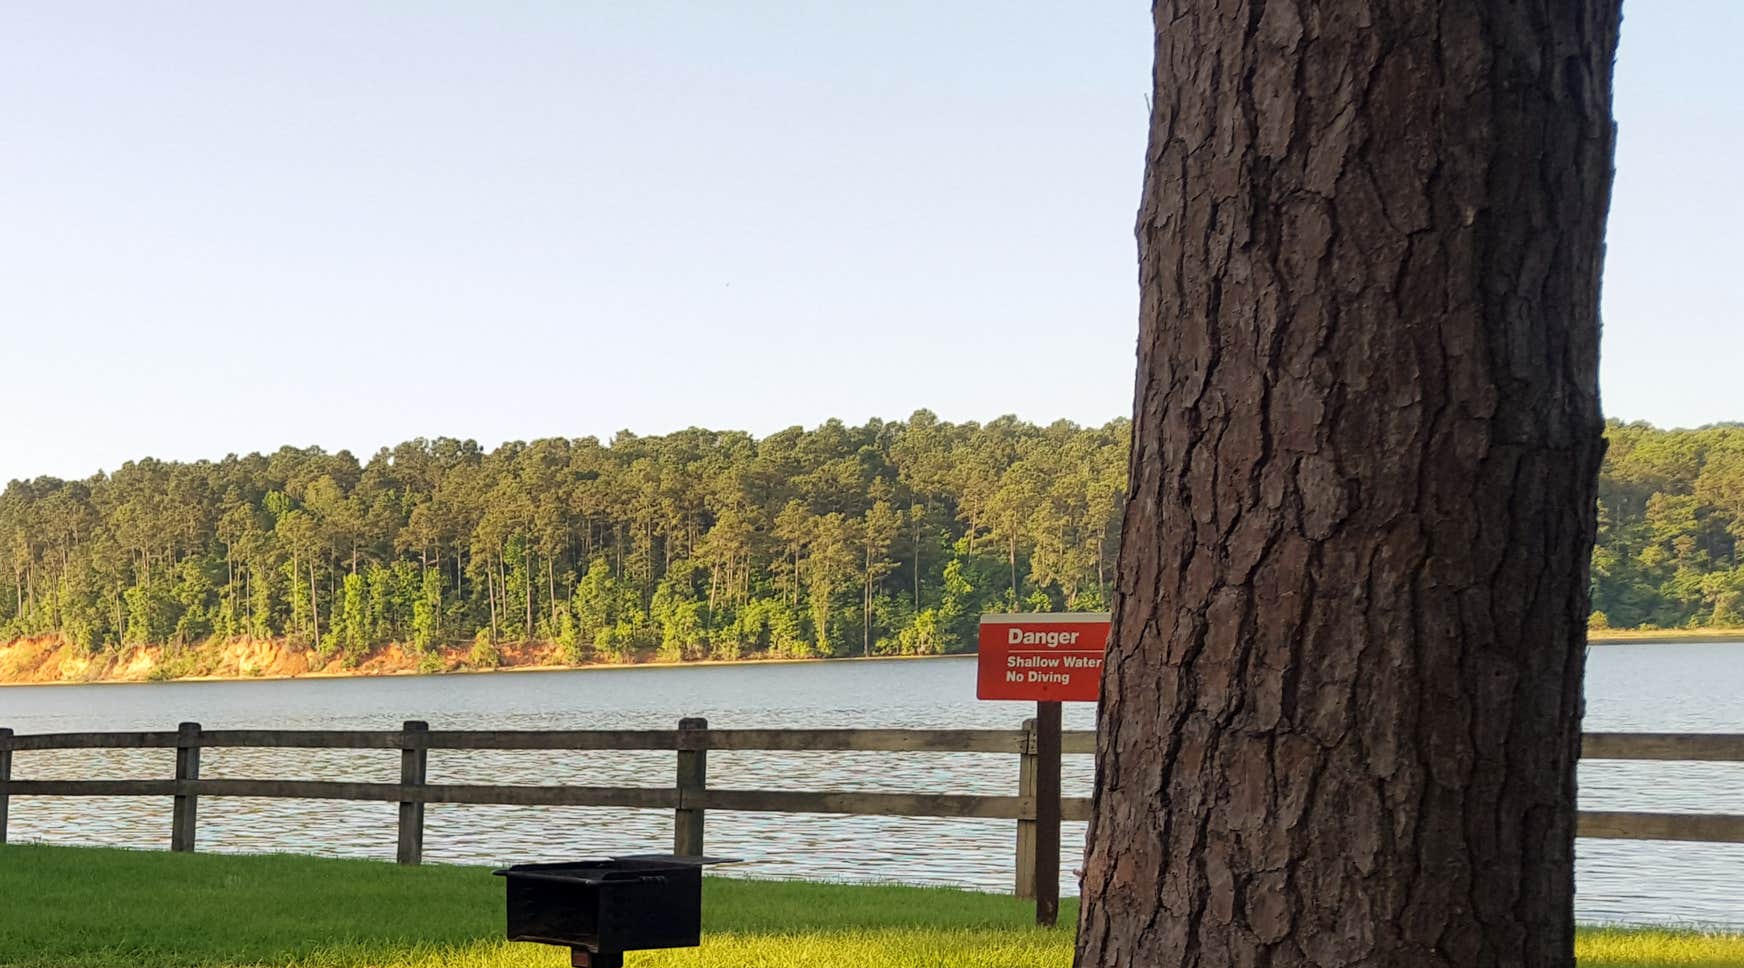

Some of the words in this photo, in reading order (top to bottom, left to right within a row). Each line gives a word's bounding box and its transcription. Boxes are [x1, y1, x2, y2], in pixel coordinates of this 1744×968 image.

[1008, 628, 1079, 647] Danger
[1007, 656, 1059, 668] Shallow
[1063, 656, 1102, 668] Water
[1006, 671, 1024, 682] No
[1028, 671, 1070, 685] Diving
